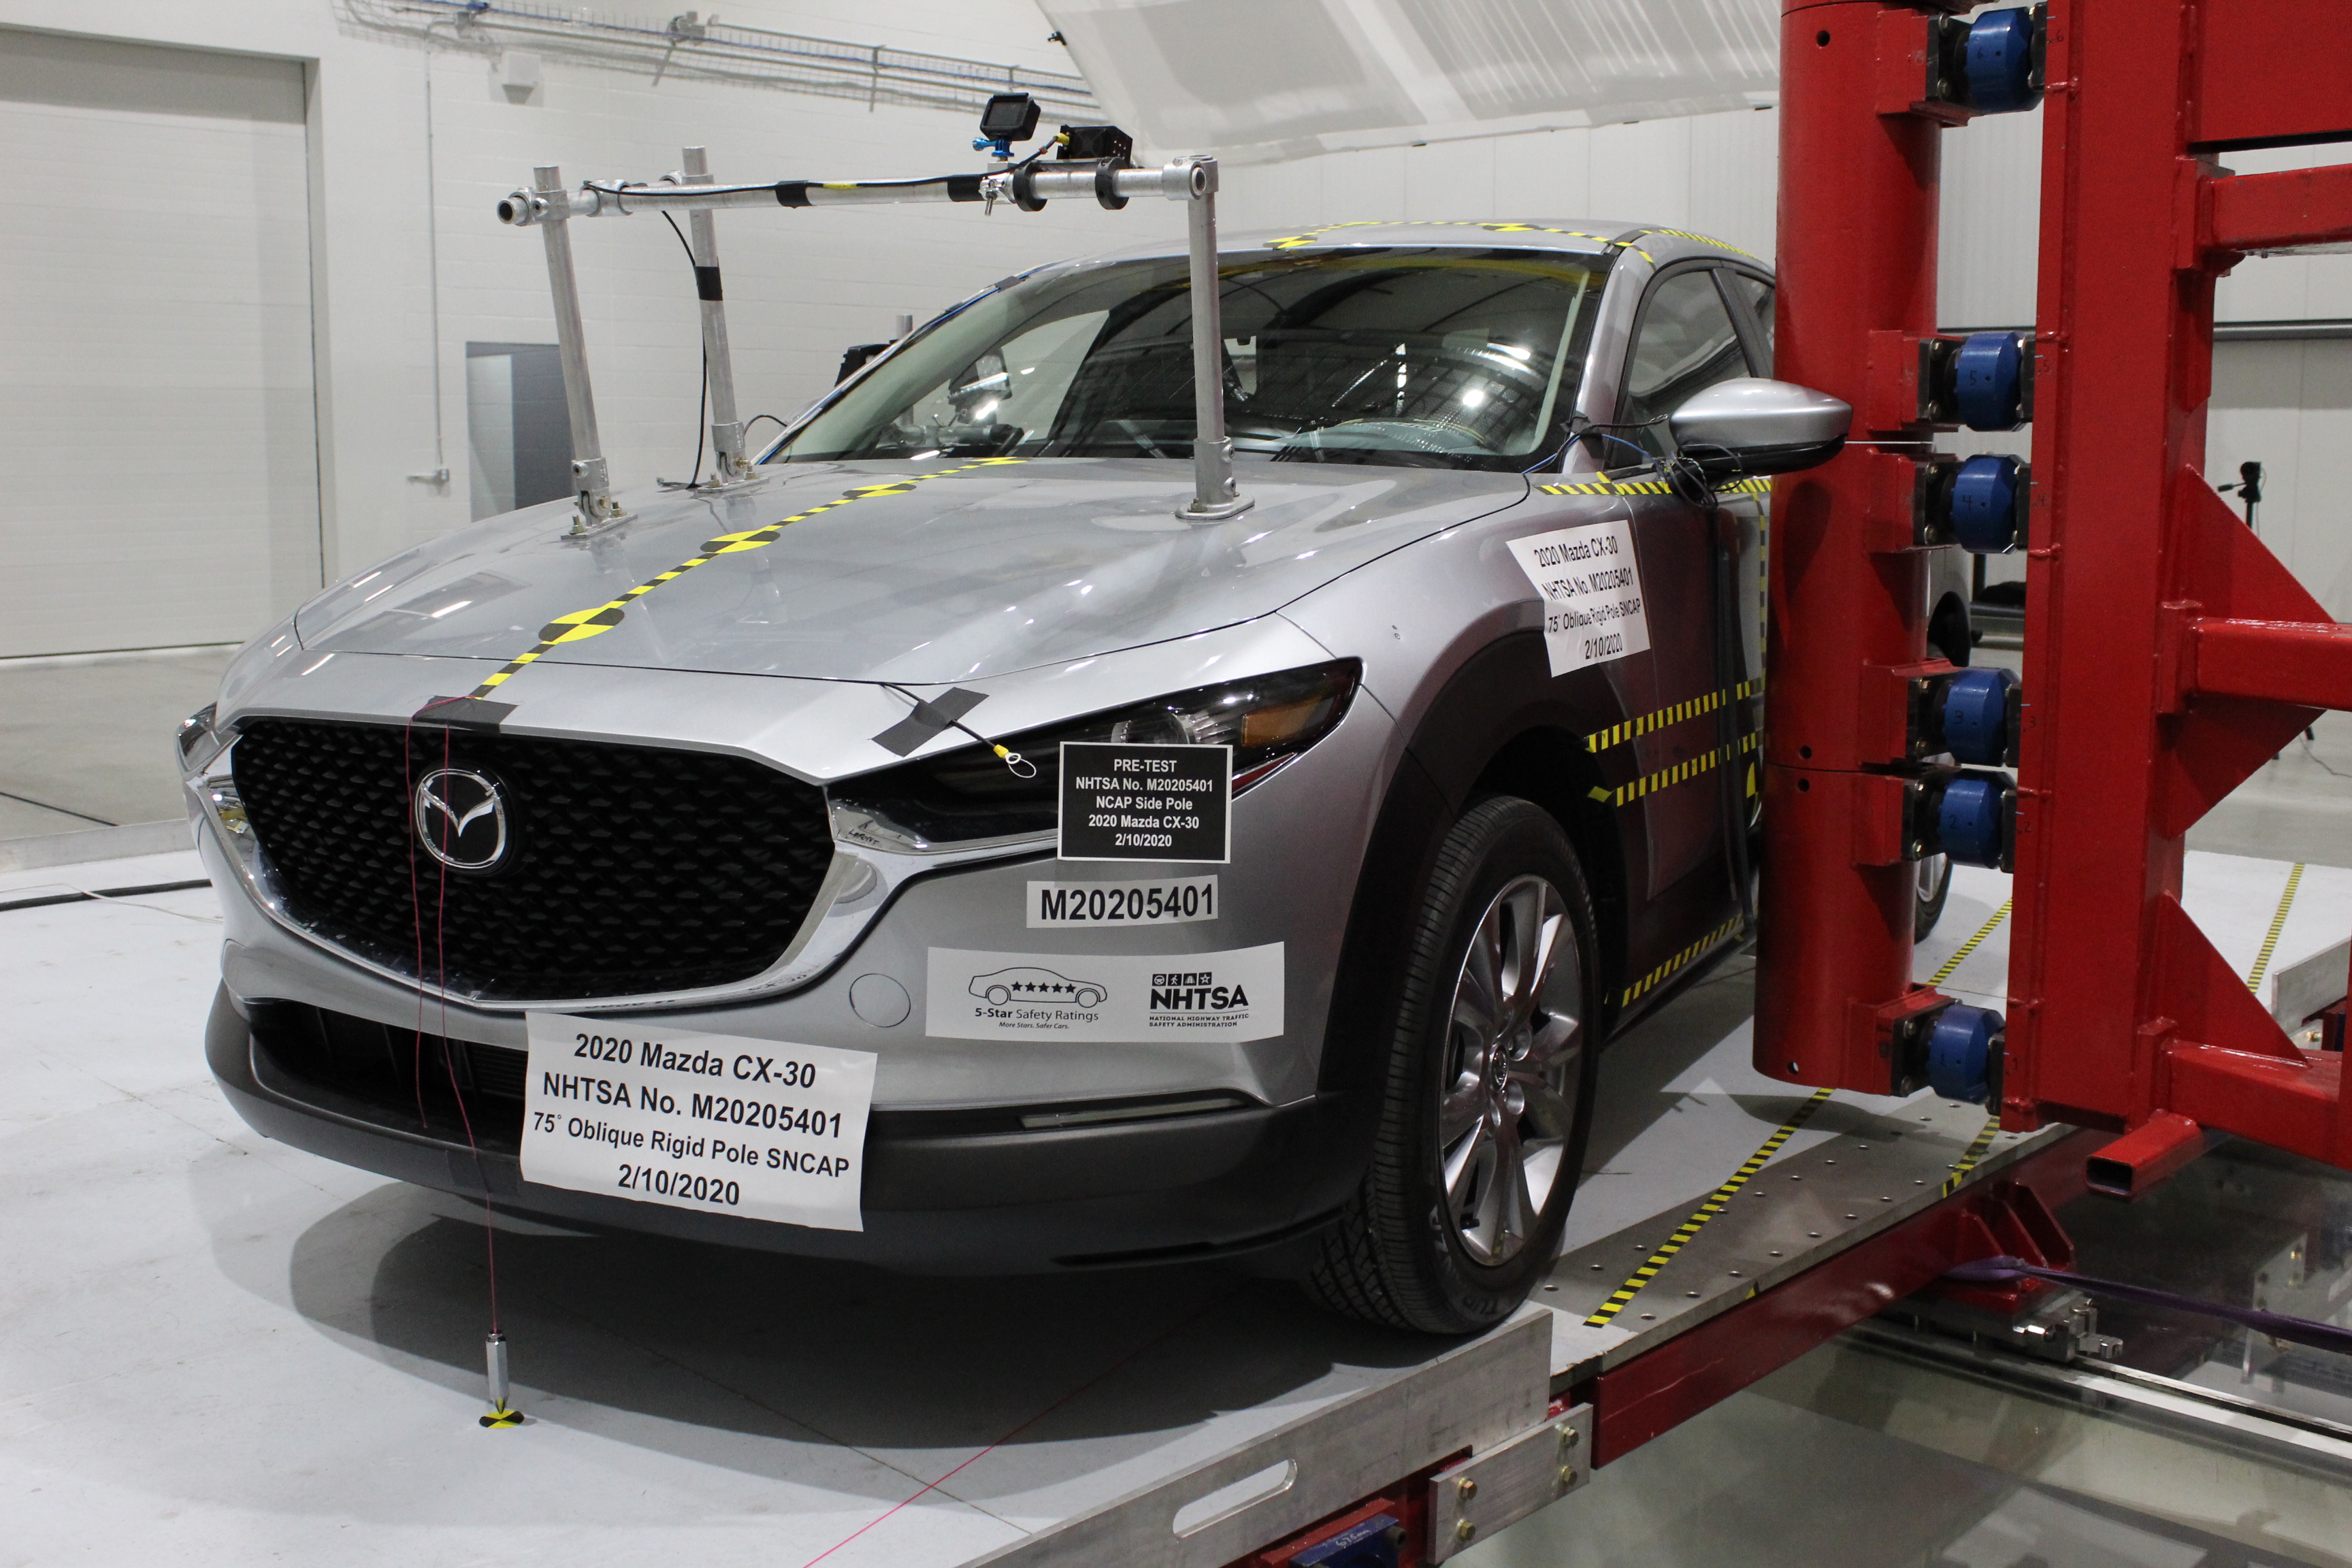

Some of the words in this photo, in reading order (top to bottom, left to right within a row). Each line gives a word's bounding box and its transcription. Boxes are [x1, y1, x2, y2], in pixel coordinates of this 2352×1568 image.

[1970, 370, 1977, 386] 5
[1963, 495, 1973, 510] 4
[1534, 546, 1561, 568] 2020
[1558, 540, 1591, 563] Mazda
[1590, 536, 1618, 557] CX-30
[1541, 579, 1576, 601] NHTSA
[1573, 576, 1590, 596] No.
[1588, 567, 1633, 593] M20205401
[1563, 608, 1592, 630] Oblique
[1590, 605, 1605, 626] Rigid
[1605, 604, 1620, 624] Pole
[1619, 598, 1641, 616] SNCAP
[1585, 633, 1623, 659] 2/10/2020
[1954, 710, 1963, 725] 3
[1113, 759, 1177, 772] PRE-TEST
[1076, 777, 1120, 789] NHTSA
[1123, 778, 1143, 790] No.
[1147, 779, 1213, 791] M20205401
[1096, 796, 1132, 808] NCAP
[1135, 797, 1162, 809] Side
[1166, 798, 1193, 810] Pole
[1088, 815, 1117, 827] 2020
[1121, 815, 1160, 828] Mazda
[1163, 816, 1200, 829] CX-30
[1948, 815, 1958, 829] 2
[1115, 834, 1173, 847] 2/10/2020
[1041, 883, 1213, 920] M20205401
[1150, 984, 1249, 1010] NHTSA
[975, 1008, 1013, 1018] 5-Star
[1016, 1009, 1052, 1022] Safety
[1056, 1011, 1098, 1023] Ratings
[574, 1033, 633, 1064] 2020
[640, 1042, 723, 1077] Mazda
[733, 1054, 816, 1089] CX-30
[544, 1071, 631, 1109] NHTSA
[640, 1086, 681, 1116] No.
[691, 1093, 842, 1139] M20205401
[568, 1117, 644, 1149] Oblique
[651, 1133, 705, 1160] Rigid
[712, 1140, 759, 1166] Pole
[766, 1148, 849, 1178] SNCAP
[618, 1164, 740, 1206] 2/10/2020
